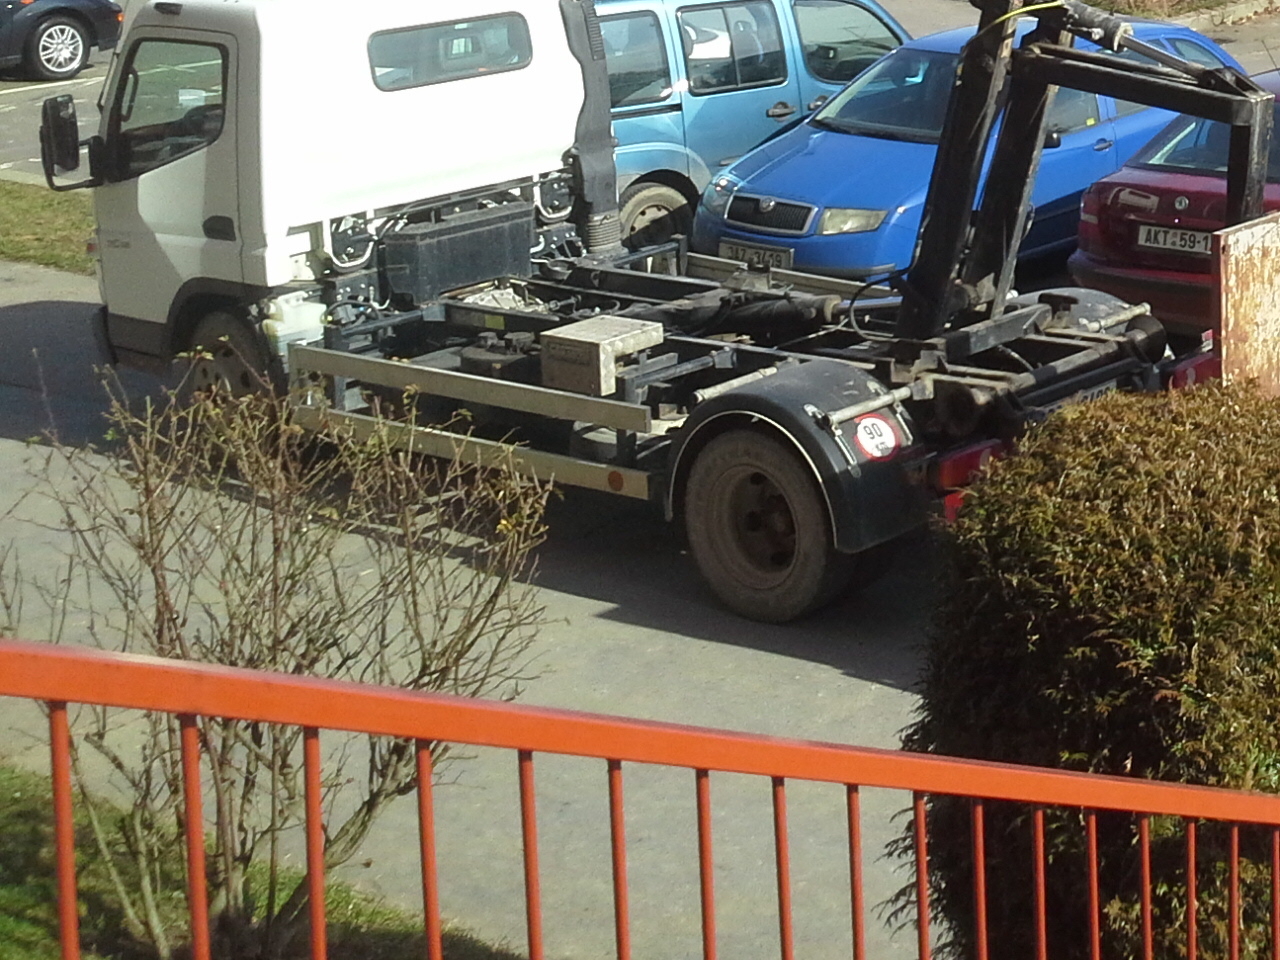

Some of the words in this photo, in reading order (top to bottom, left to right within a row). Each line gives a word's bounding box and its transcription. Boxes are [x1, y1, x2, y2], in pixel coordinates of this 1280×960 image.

[1144, 228, 1170, 246] AKT
[1179, 232, 1210, 251] 59-1
[863, 422, 884, 440] 90
